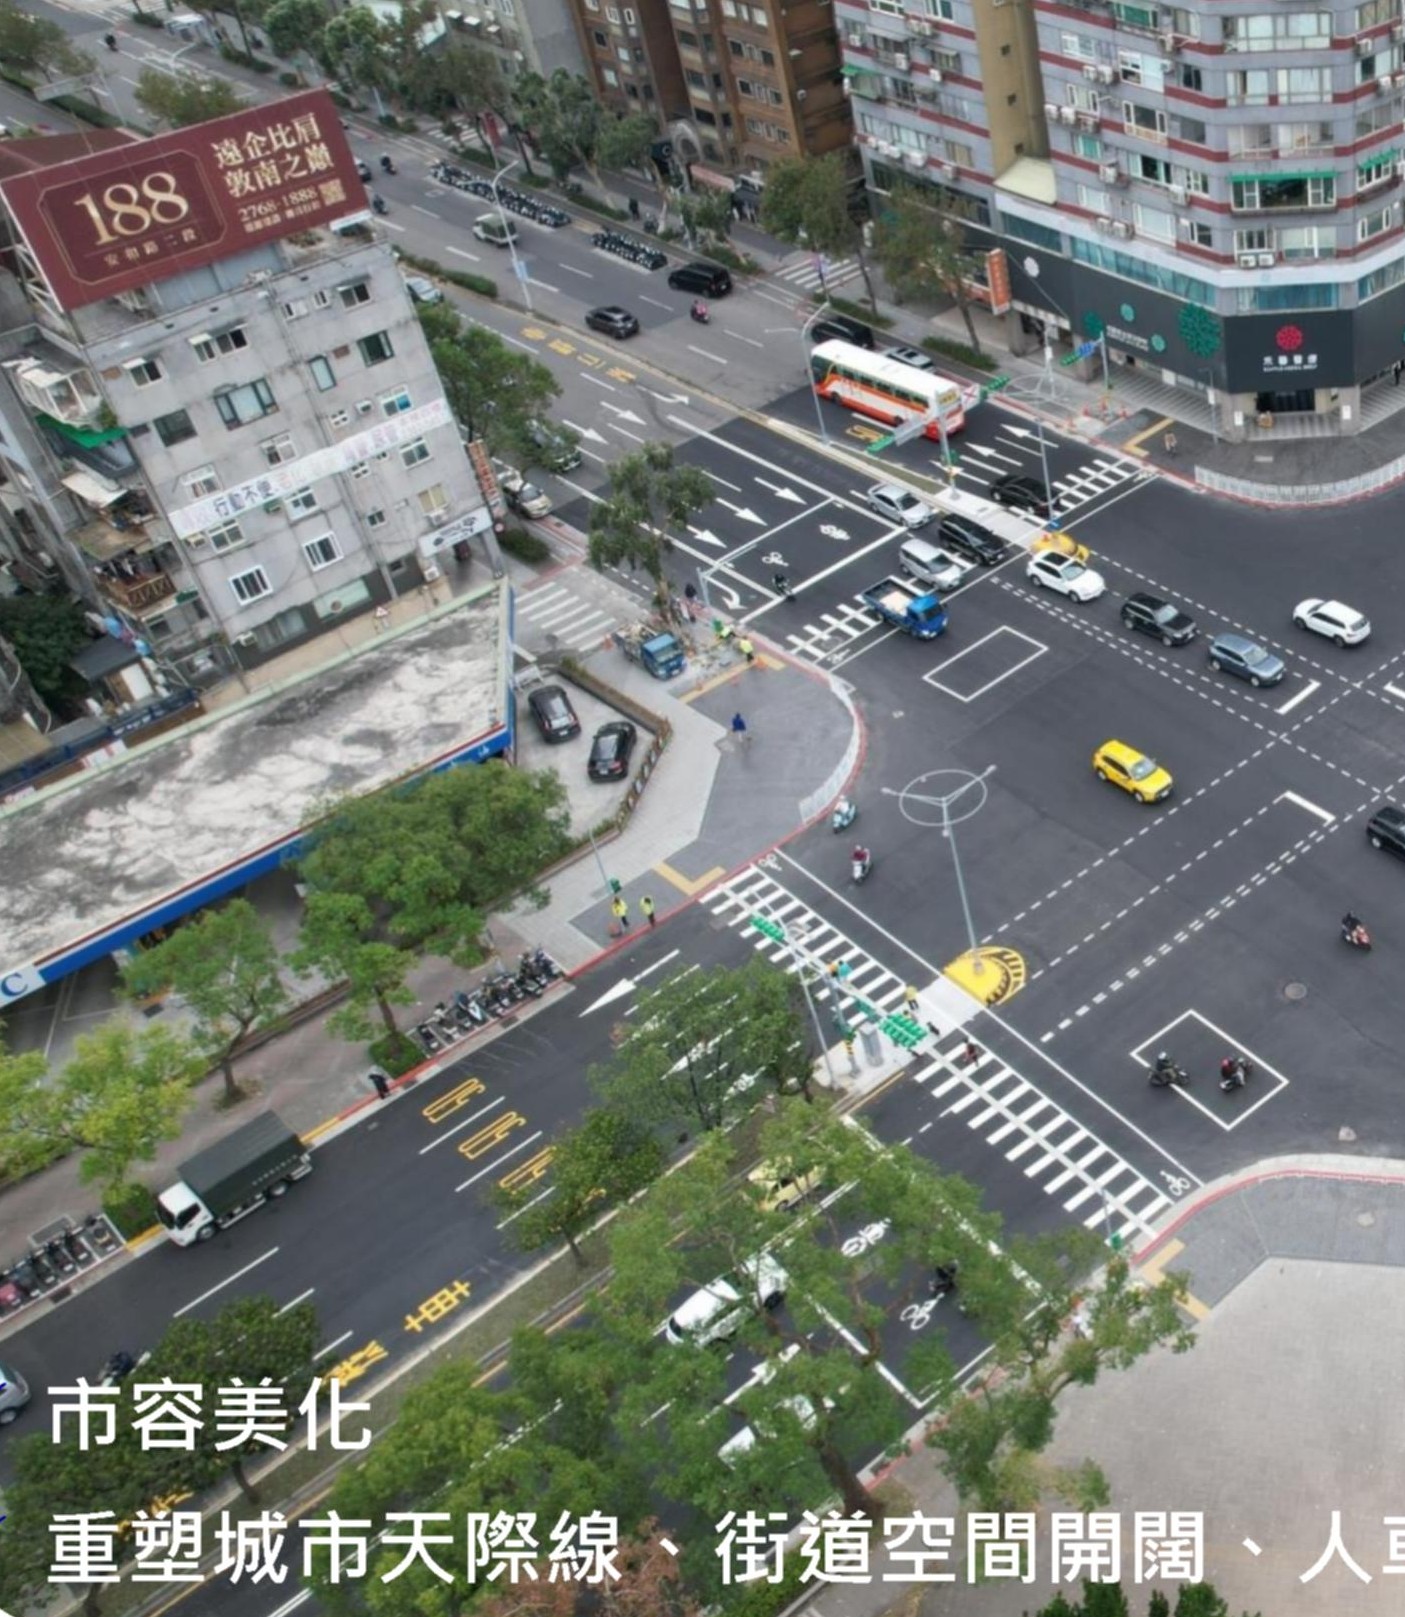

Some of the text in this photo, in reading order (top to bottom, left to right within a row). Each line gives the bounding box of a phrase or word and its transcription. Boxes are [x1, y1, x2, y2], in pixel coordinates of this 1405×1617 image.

[211, 113, 322, 169] 遠企比肩
[75, 171, 190, 246] 188
[238, 186, 318, 223] 2768-1888
